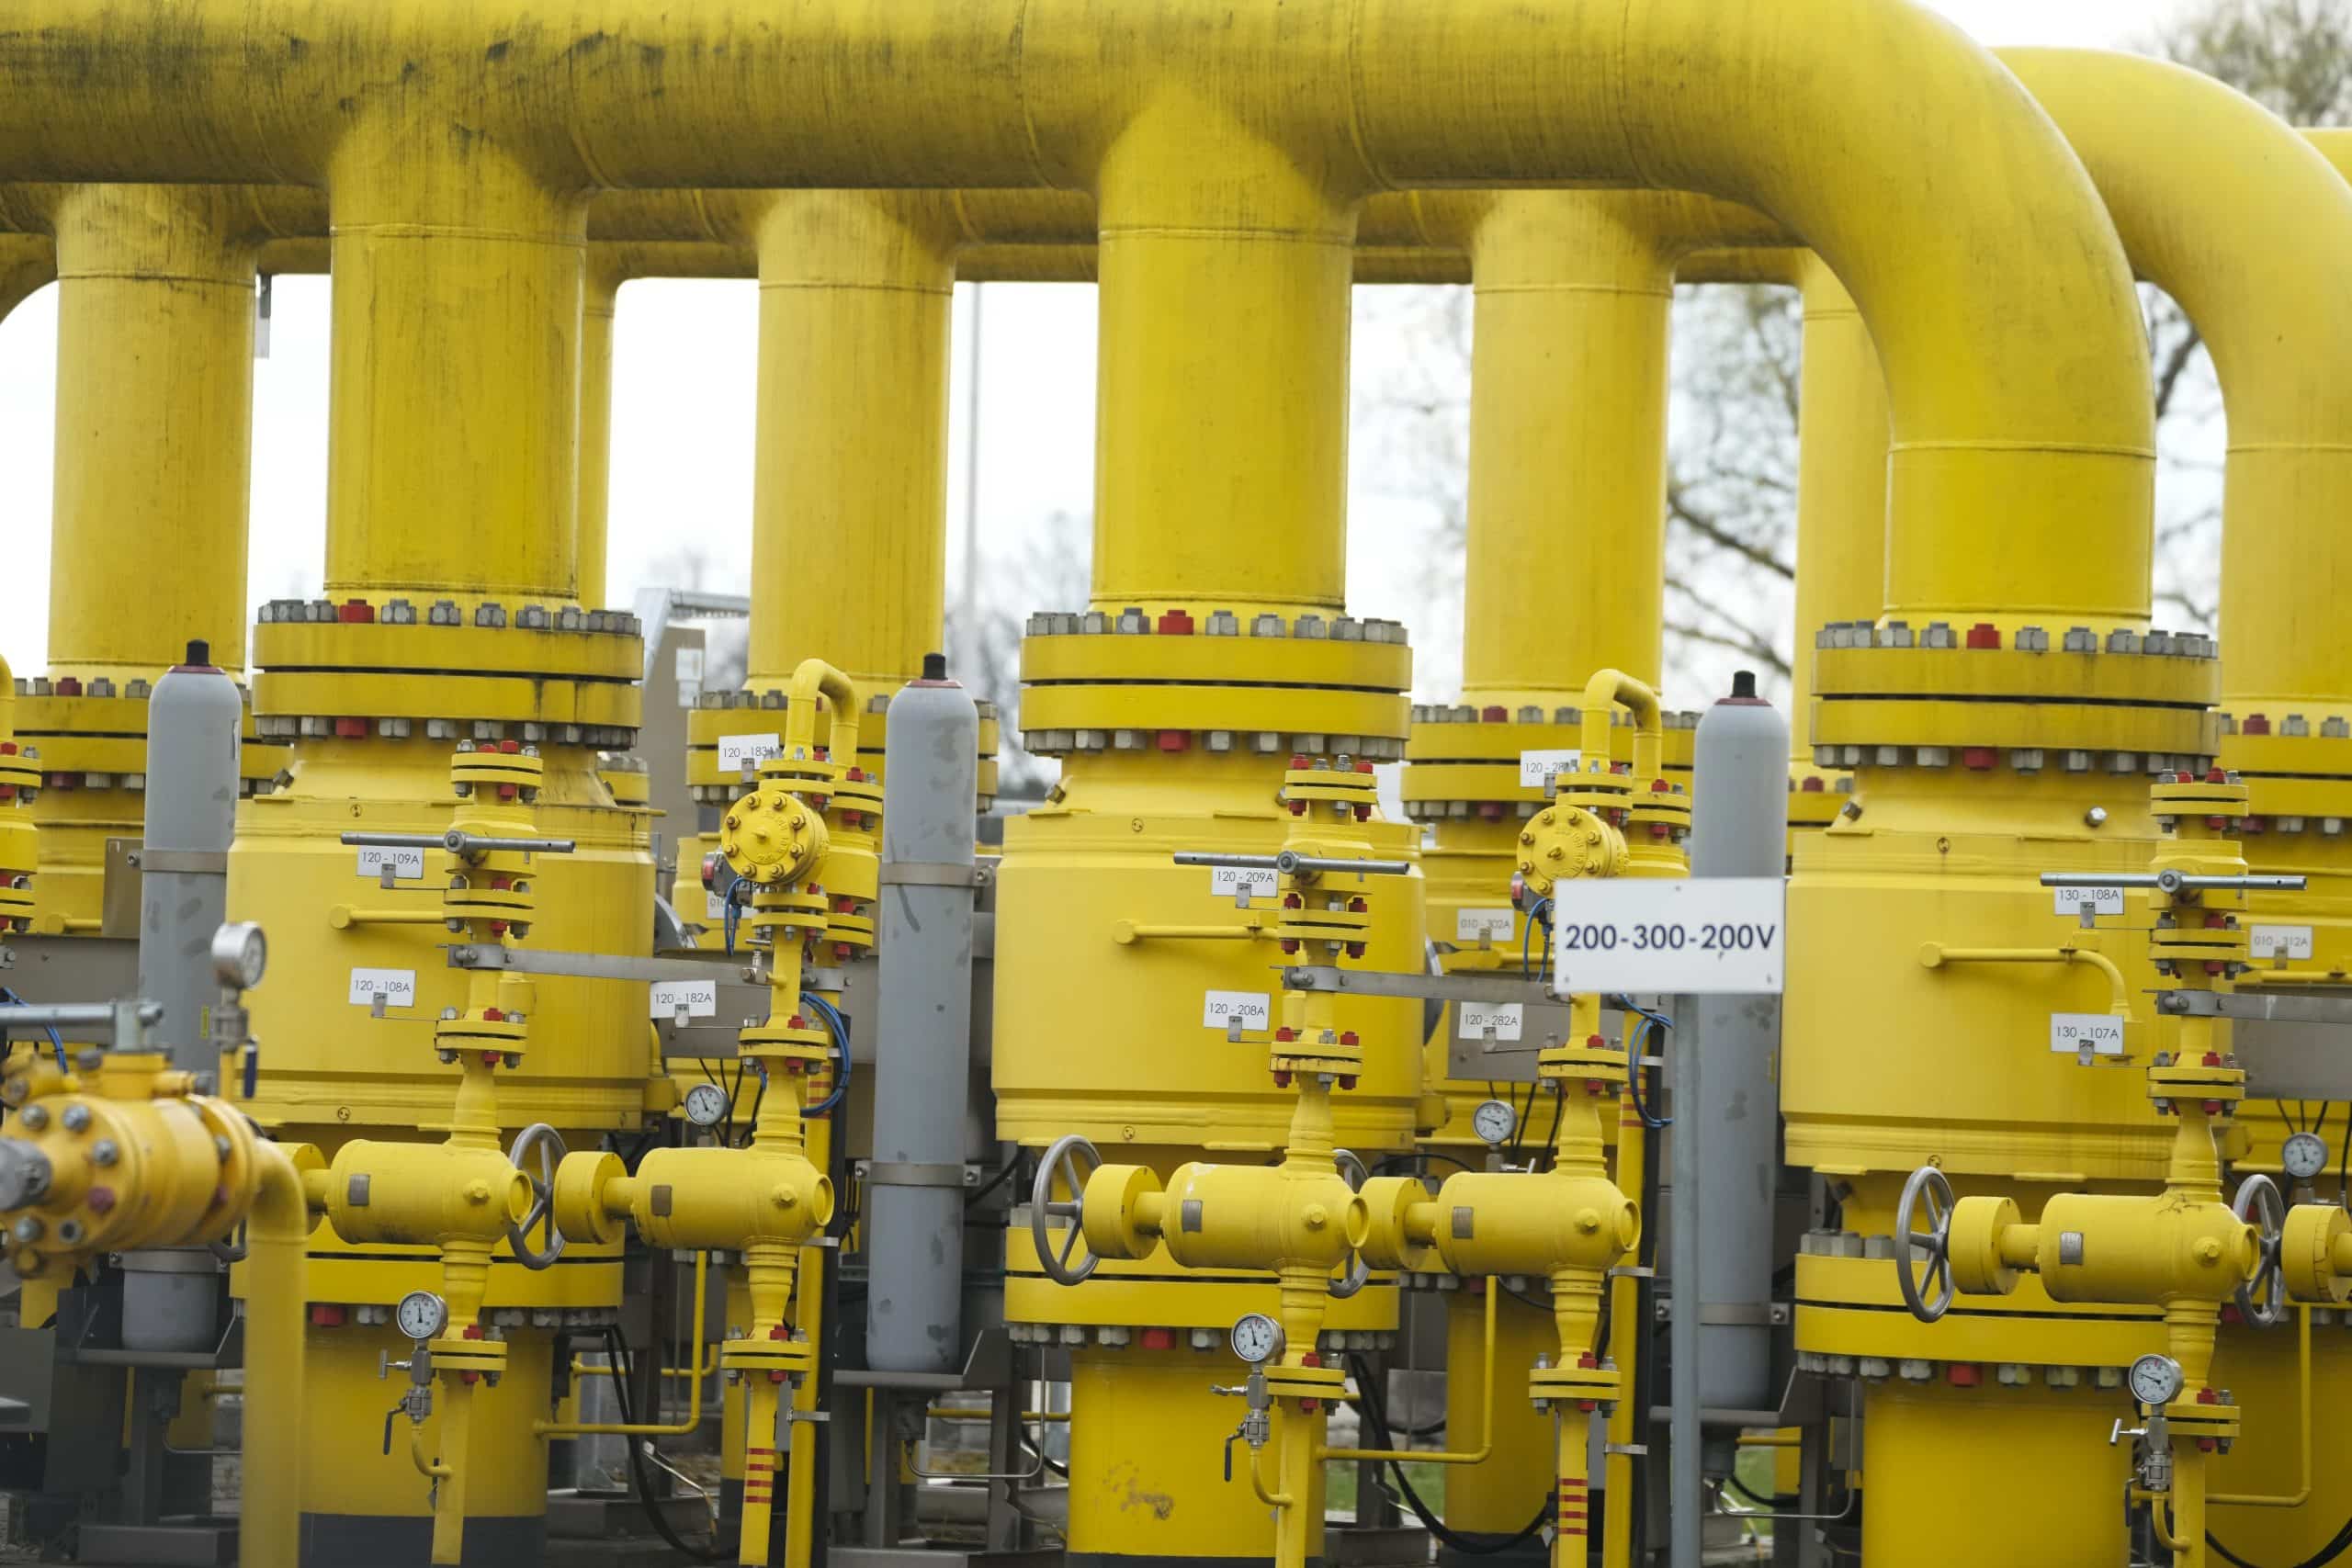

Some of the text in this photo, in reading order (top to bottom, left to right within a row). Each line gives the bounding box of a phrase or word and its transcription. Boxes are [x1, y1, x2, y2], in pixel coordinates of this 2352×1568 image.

[723, 748, 741, 758] 120
[1525, 762, 1543, 773] 120
[363, 852, 381, 863] 120
[392, 853, 419, 864] 109A
[1217, 871, 1236, 882] 120
[1246, 872, 1273, 883] 209A
[2060, 889, 2079, 901] 130
[2091, 889, 2120, 900] 108A
[1565, 924, 1775, 950] 200-300-200V
[355, 979, 374, 991] 120
[384, 981, 412, 993] 108A
[655, 994, 673, 1004] 120
[685, 993, 712, 1003] 182A
[1210, 1003, 1227, 1014] 120
[1238, 1005, 1264, 1016] 208A
[1464, 1014, 1482, 1025] 120
[1491, 1015, 1519, 1026] 282A
[2057, 1026, 2077, 1038] 130
[2089, 1028, 2119, 1039] 107A
